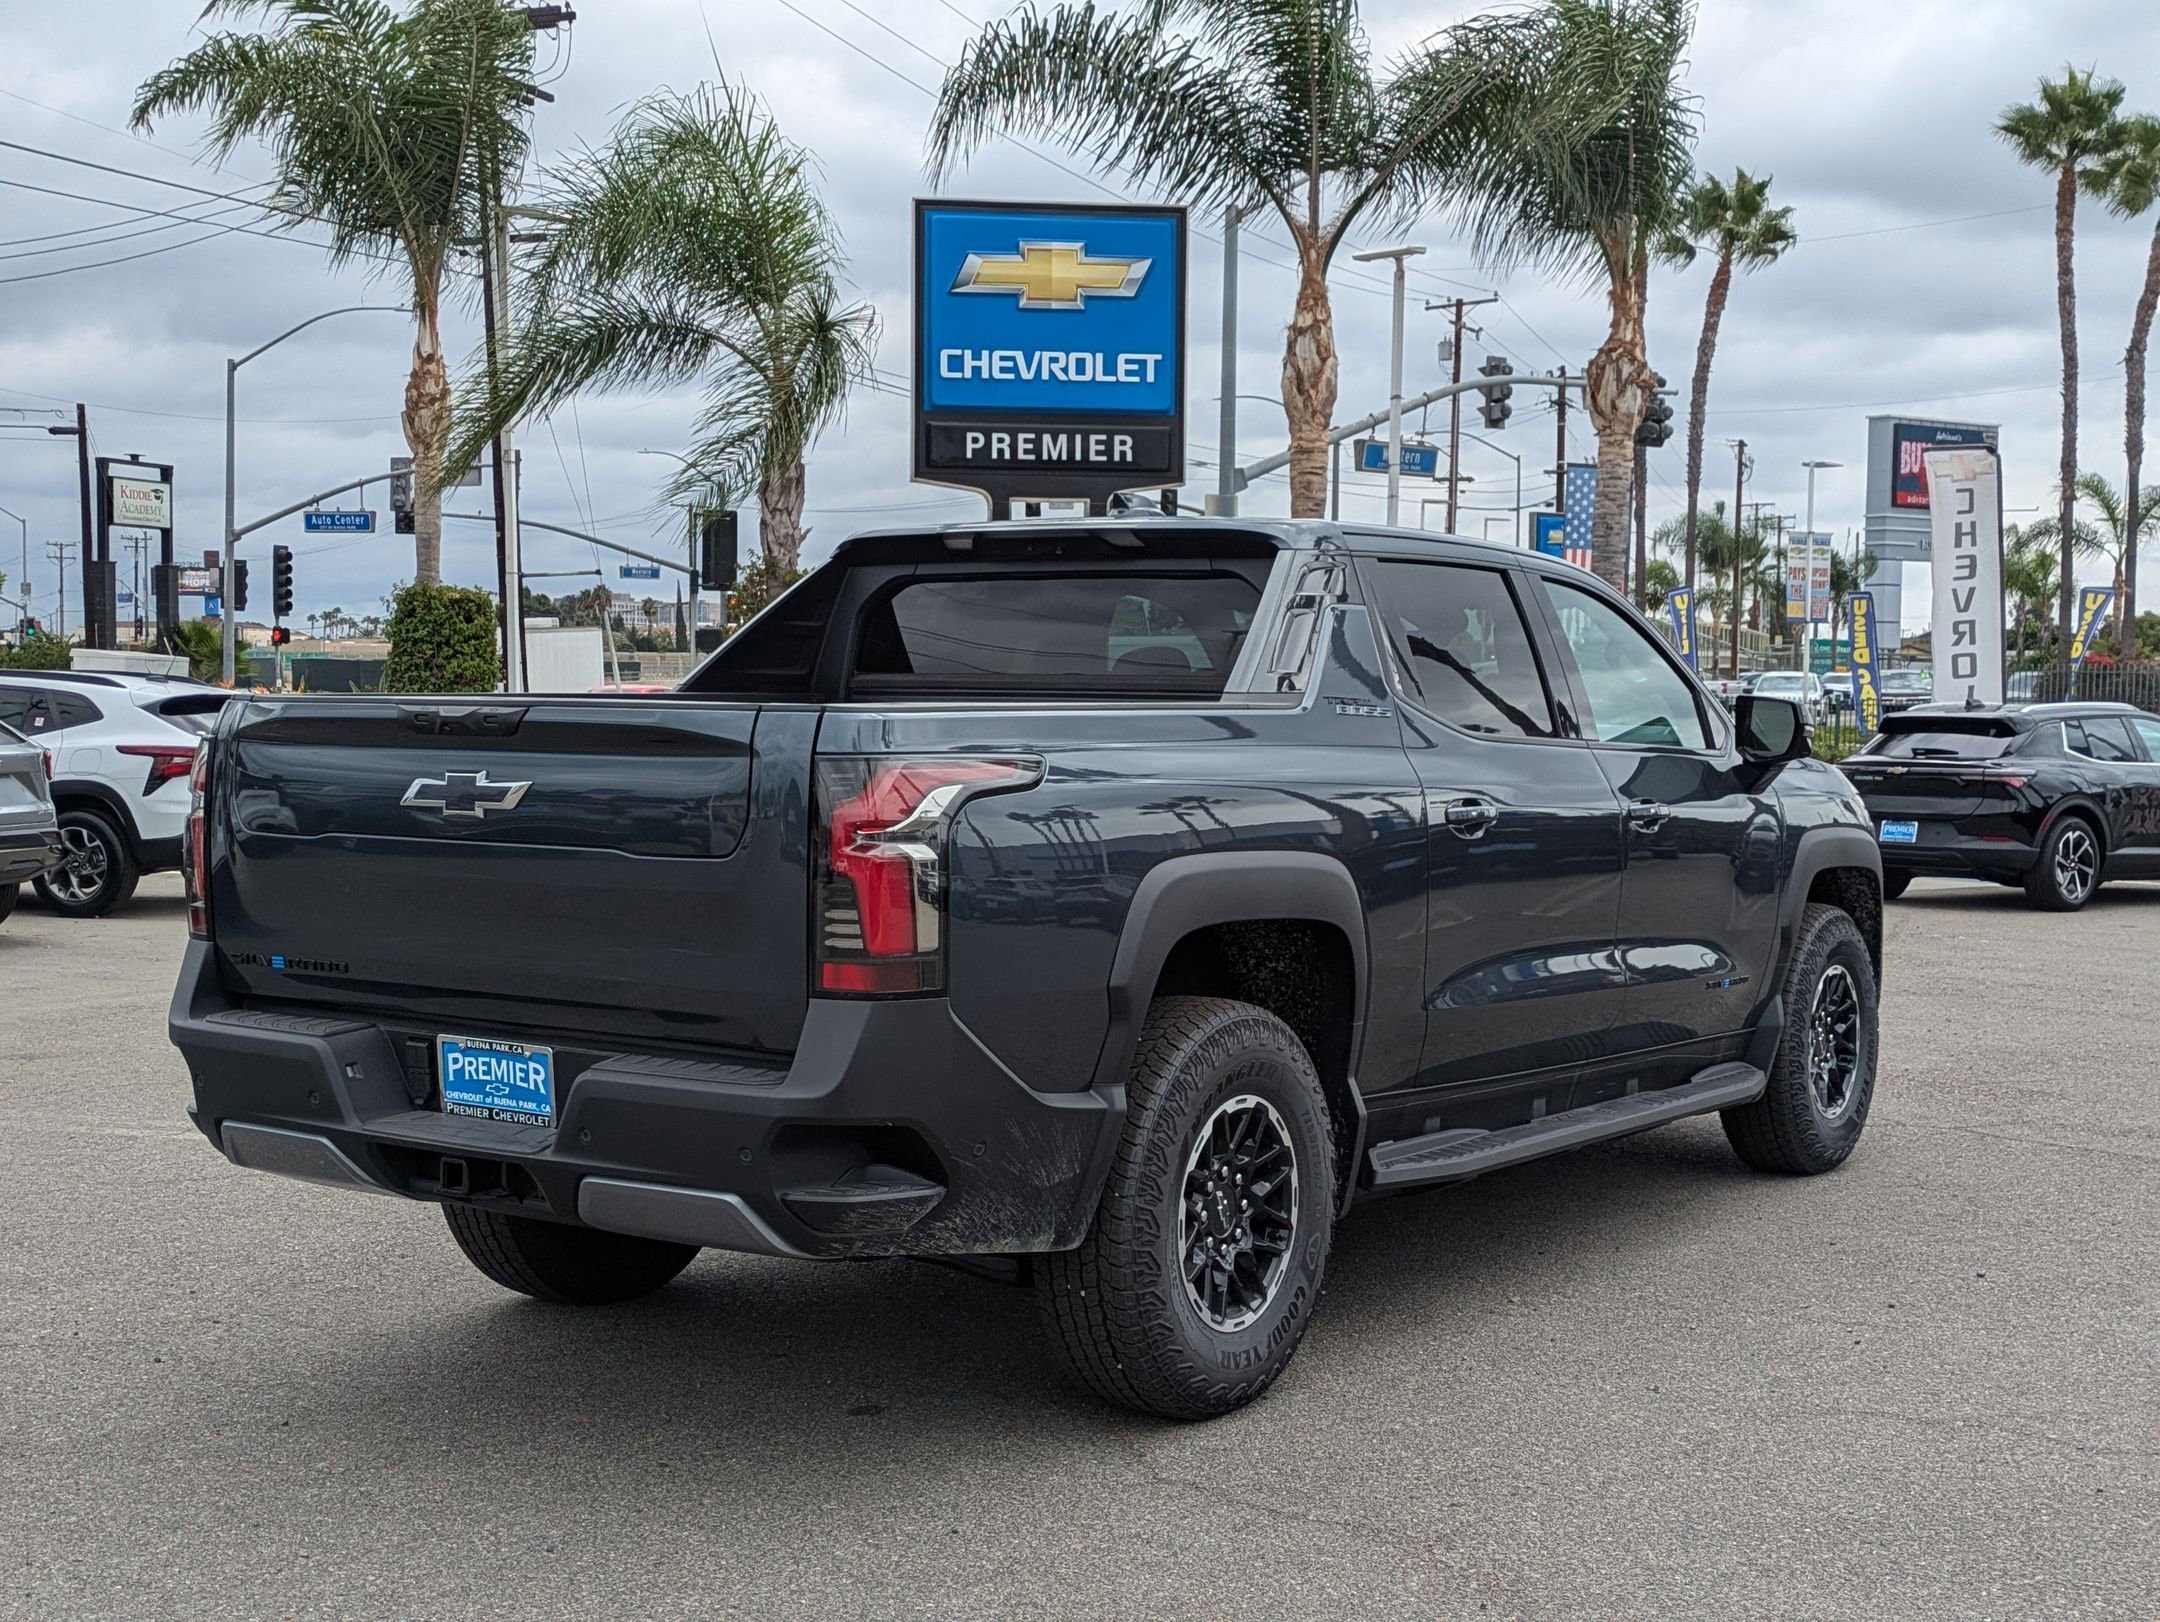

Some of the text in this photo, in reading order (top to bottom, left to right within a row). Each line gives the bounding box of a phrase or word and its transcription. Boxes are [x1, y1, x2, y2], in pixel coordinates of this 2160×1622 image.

[940, 349, 1162, 382] CHEVROLET
[966, 432, 1134, 461] PREMIER
[120, 485, 153, 501] KIDDIE
[120, 500, 161, 516] ACADEMY
[311, 515, 365, 525] Auto Center
[1884, 825, 1914, 835] PREMIER
[466, 1040, 490, 1050] BUENA
[447, 1052, 547, 1095] PREMIER
[446, 1090, 484, 1103] CHEVROLET
[493, 1096, 518, 1107] BUENA
[541, 1103, 551, 1113] CA
[447, 1103, 550, 1127] PREMIER CHEVROLET
